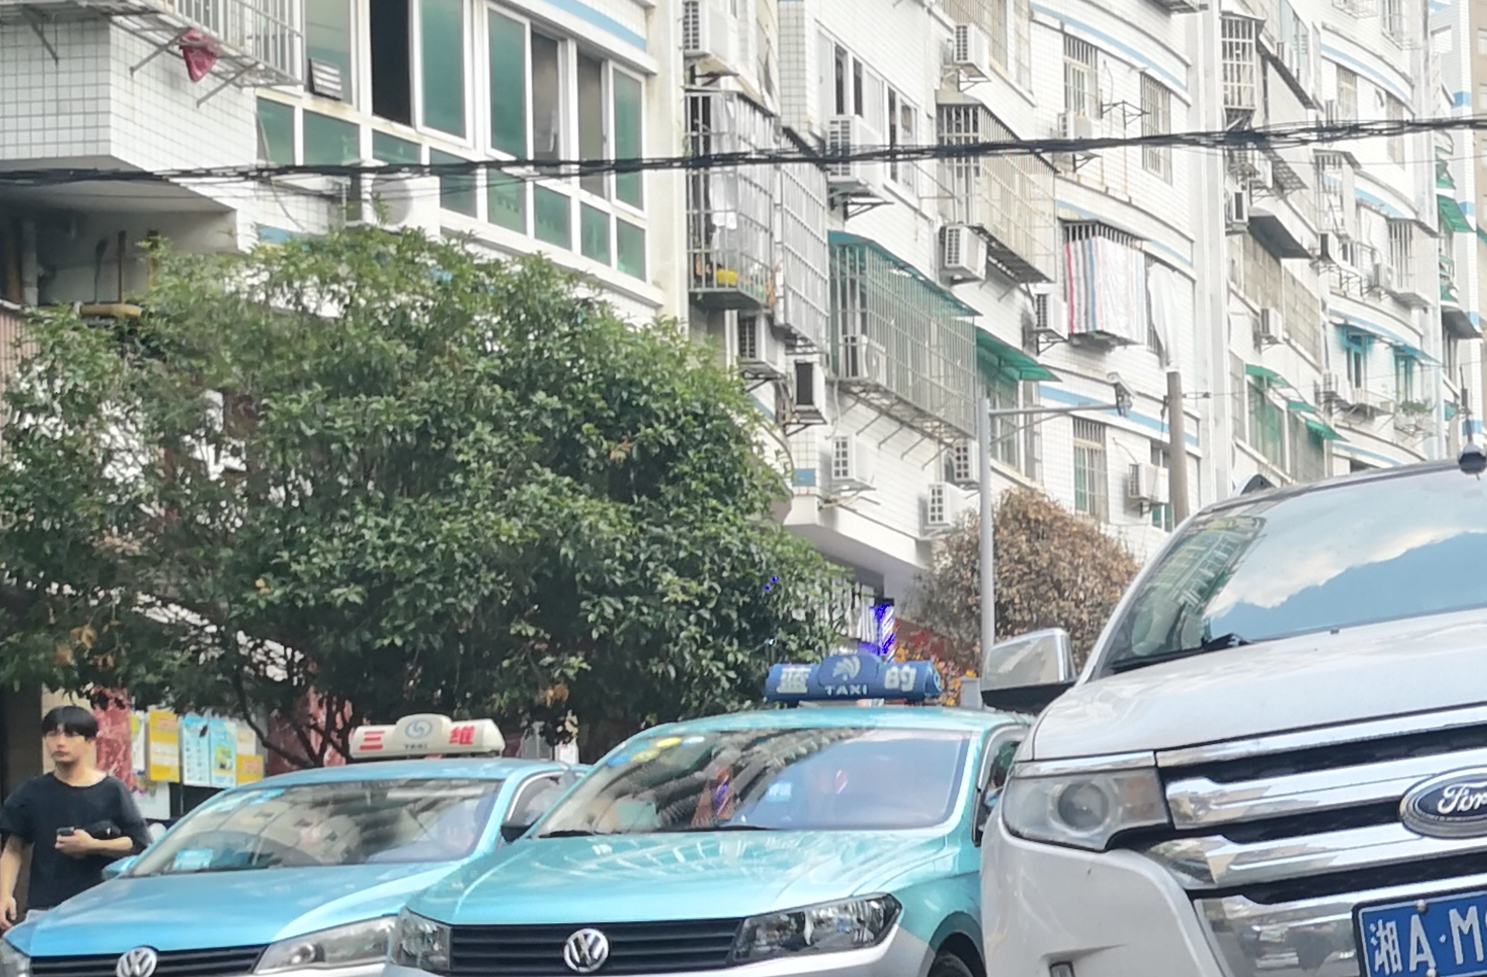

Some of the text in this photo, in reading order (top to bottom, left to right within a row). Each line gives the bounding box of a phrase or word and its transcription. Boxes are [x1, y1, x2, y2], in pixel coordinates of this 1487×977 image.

[824, 684, 868, 696] TAXI
[885, 665, 917, 692] 的
[359, 726, 476, 751] 三 维
